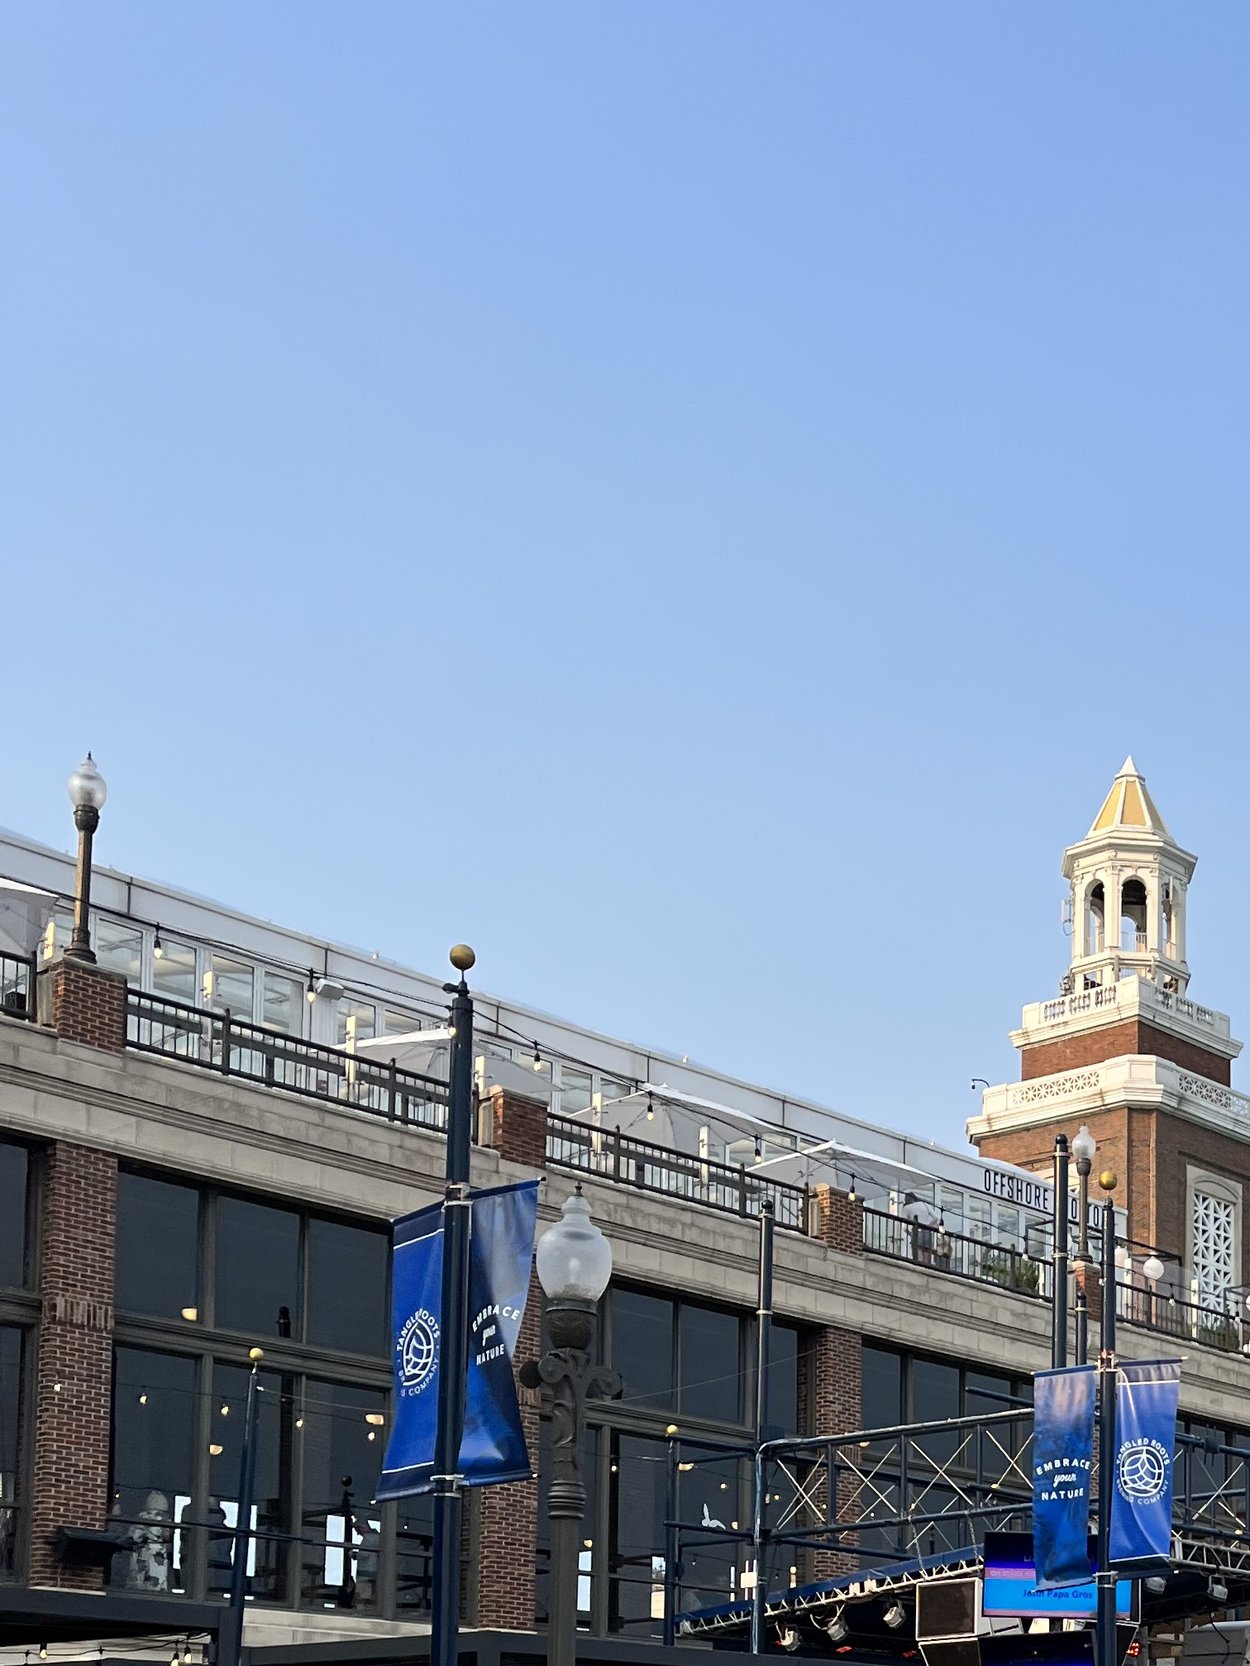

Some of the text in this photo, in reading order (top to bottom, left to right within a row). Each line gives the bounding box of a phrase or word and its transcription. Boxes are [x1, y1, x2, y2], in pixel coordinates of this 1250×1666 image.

[984, 1169, 1049, 1210] OFFSHORE
[420, 1309, 440, 1338] OOTS
[472, 1304, 520, 1332] EMBRACE
[476, 1343, 505, 1366] NATURE
[408, 1357, 438, 1396] COMPANY
[1116, 1437, 1170, 1466] TANGLED ROOTS
[1035, 1458, 1090, 1476] EMBRACE
[1053, 1473, 1077, 1488] your
[1137, 1479, 1169, 1505] COMPANY
[1041, 1487, 1084, 1501] NATURE
[1047, 1589, 1069, 1600] Papa
[1072, 1589, 1093, 1599] Gros
